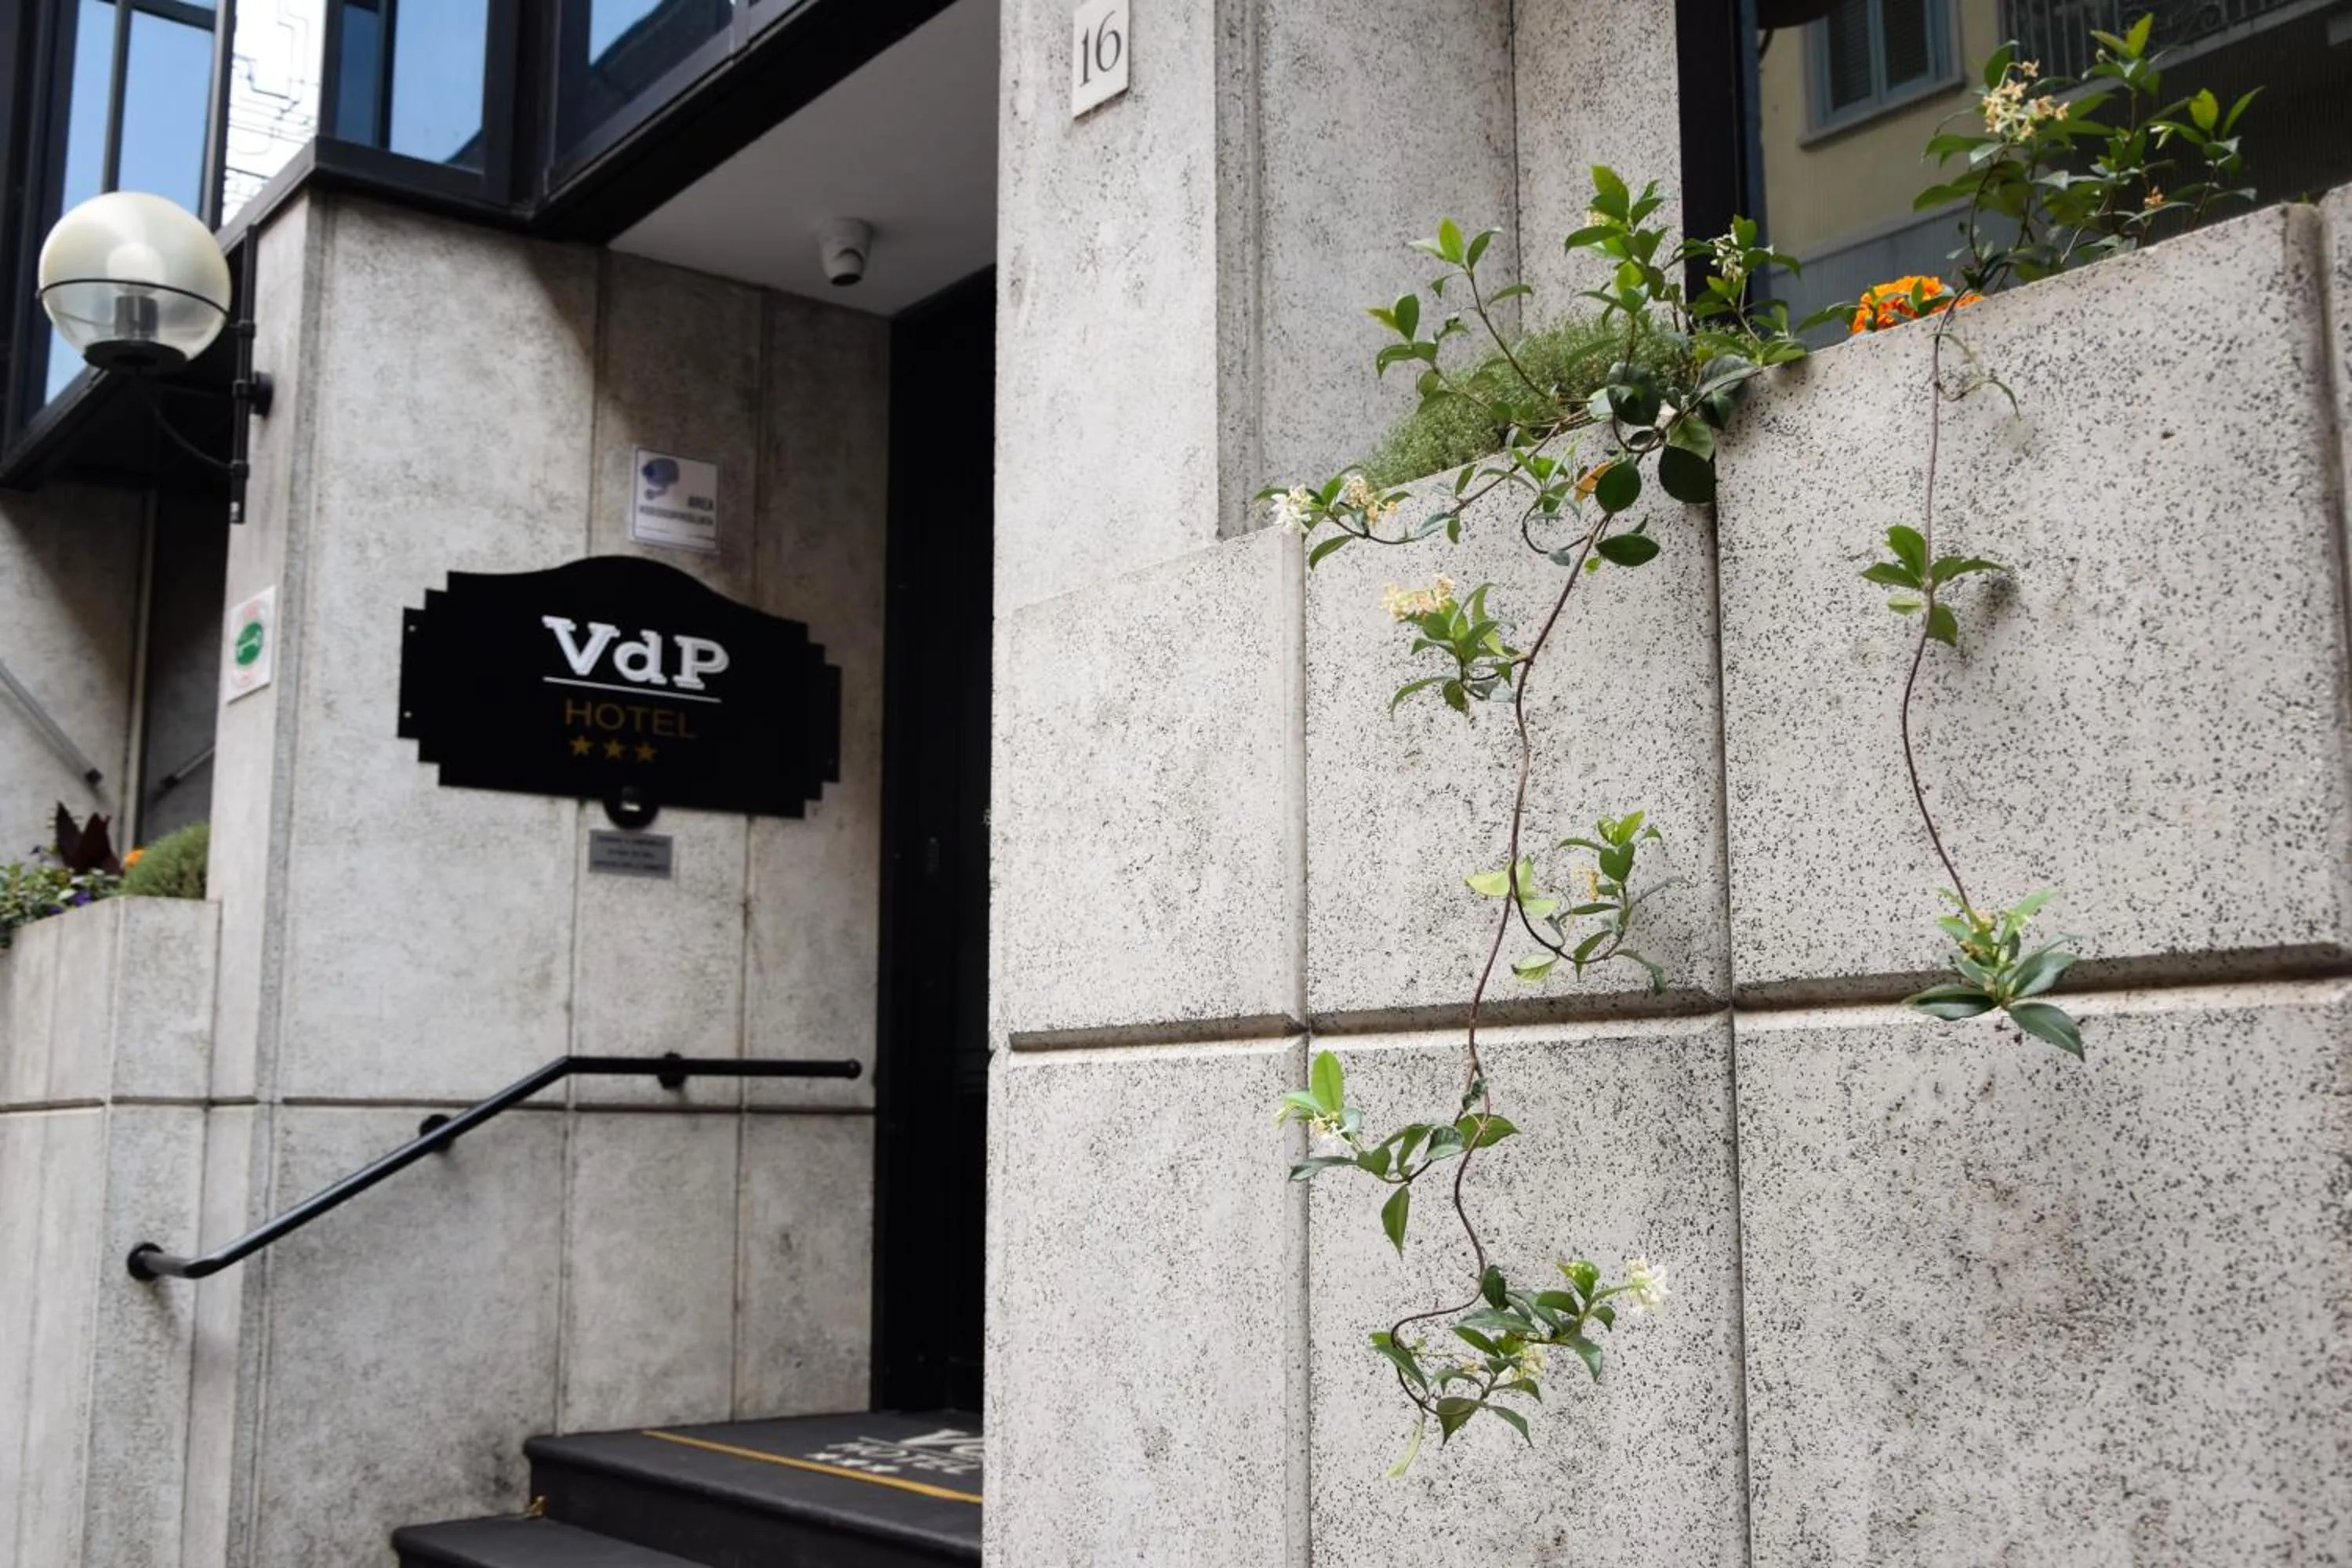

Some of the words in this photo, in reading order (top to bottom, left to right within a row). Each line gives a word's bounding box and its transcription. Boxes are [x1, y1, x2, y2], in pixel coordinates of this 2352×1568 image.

[1079, 9, 1122, 88] 16
[541, 615, 730, 690] VdP
[564, 698, 698, 739] HOTEL
